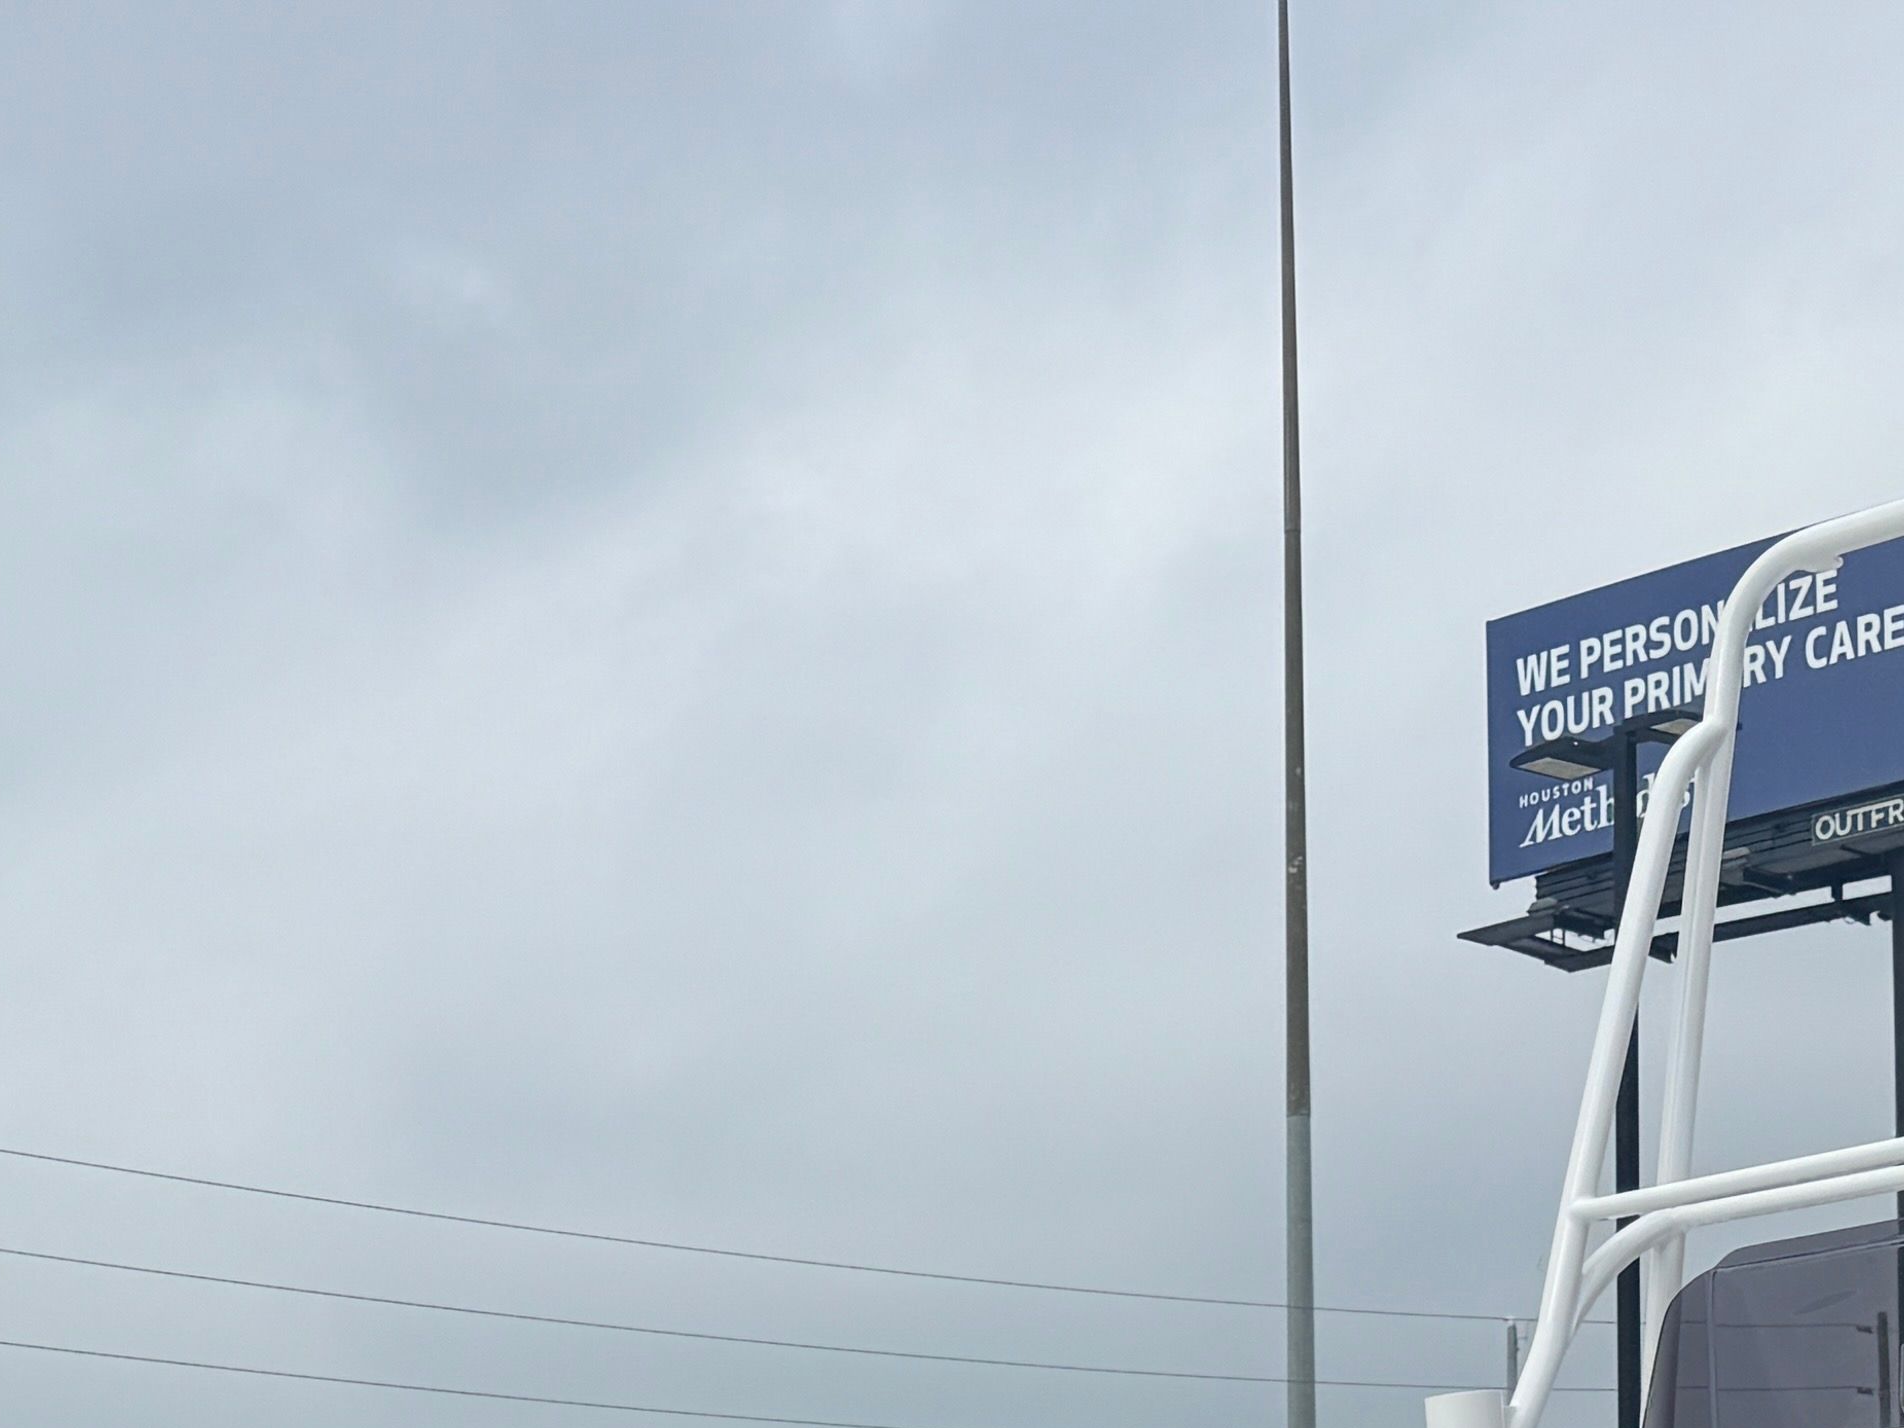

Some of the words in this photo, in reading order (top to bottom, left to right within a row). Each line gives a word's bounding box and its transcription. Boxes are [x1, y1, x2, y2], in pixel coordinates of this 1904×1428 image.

[1516, 645, 1571, 696] WE
[1580, 570, 1840, 679] PERSONLIZE
[1517, 686, 1615, 747] YOUR
[1624, 636, 1791, 719] PRIMRY
[1519, 777, 1594, 809] HOUSTON
